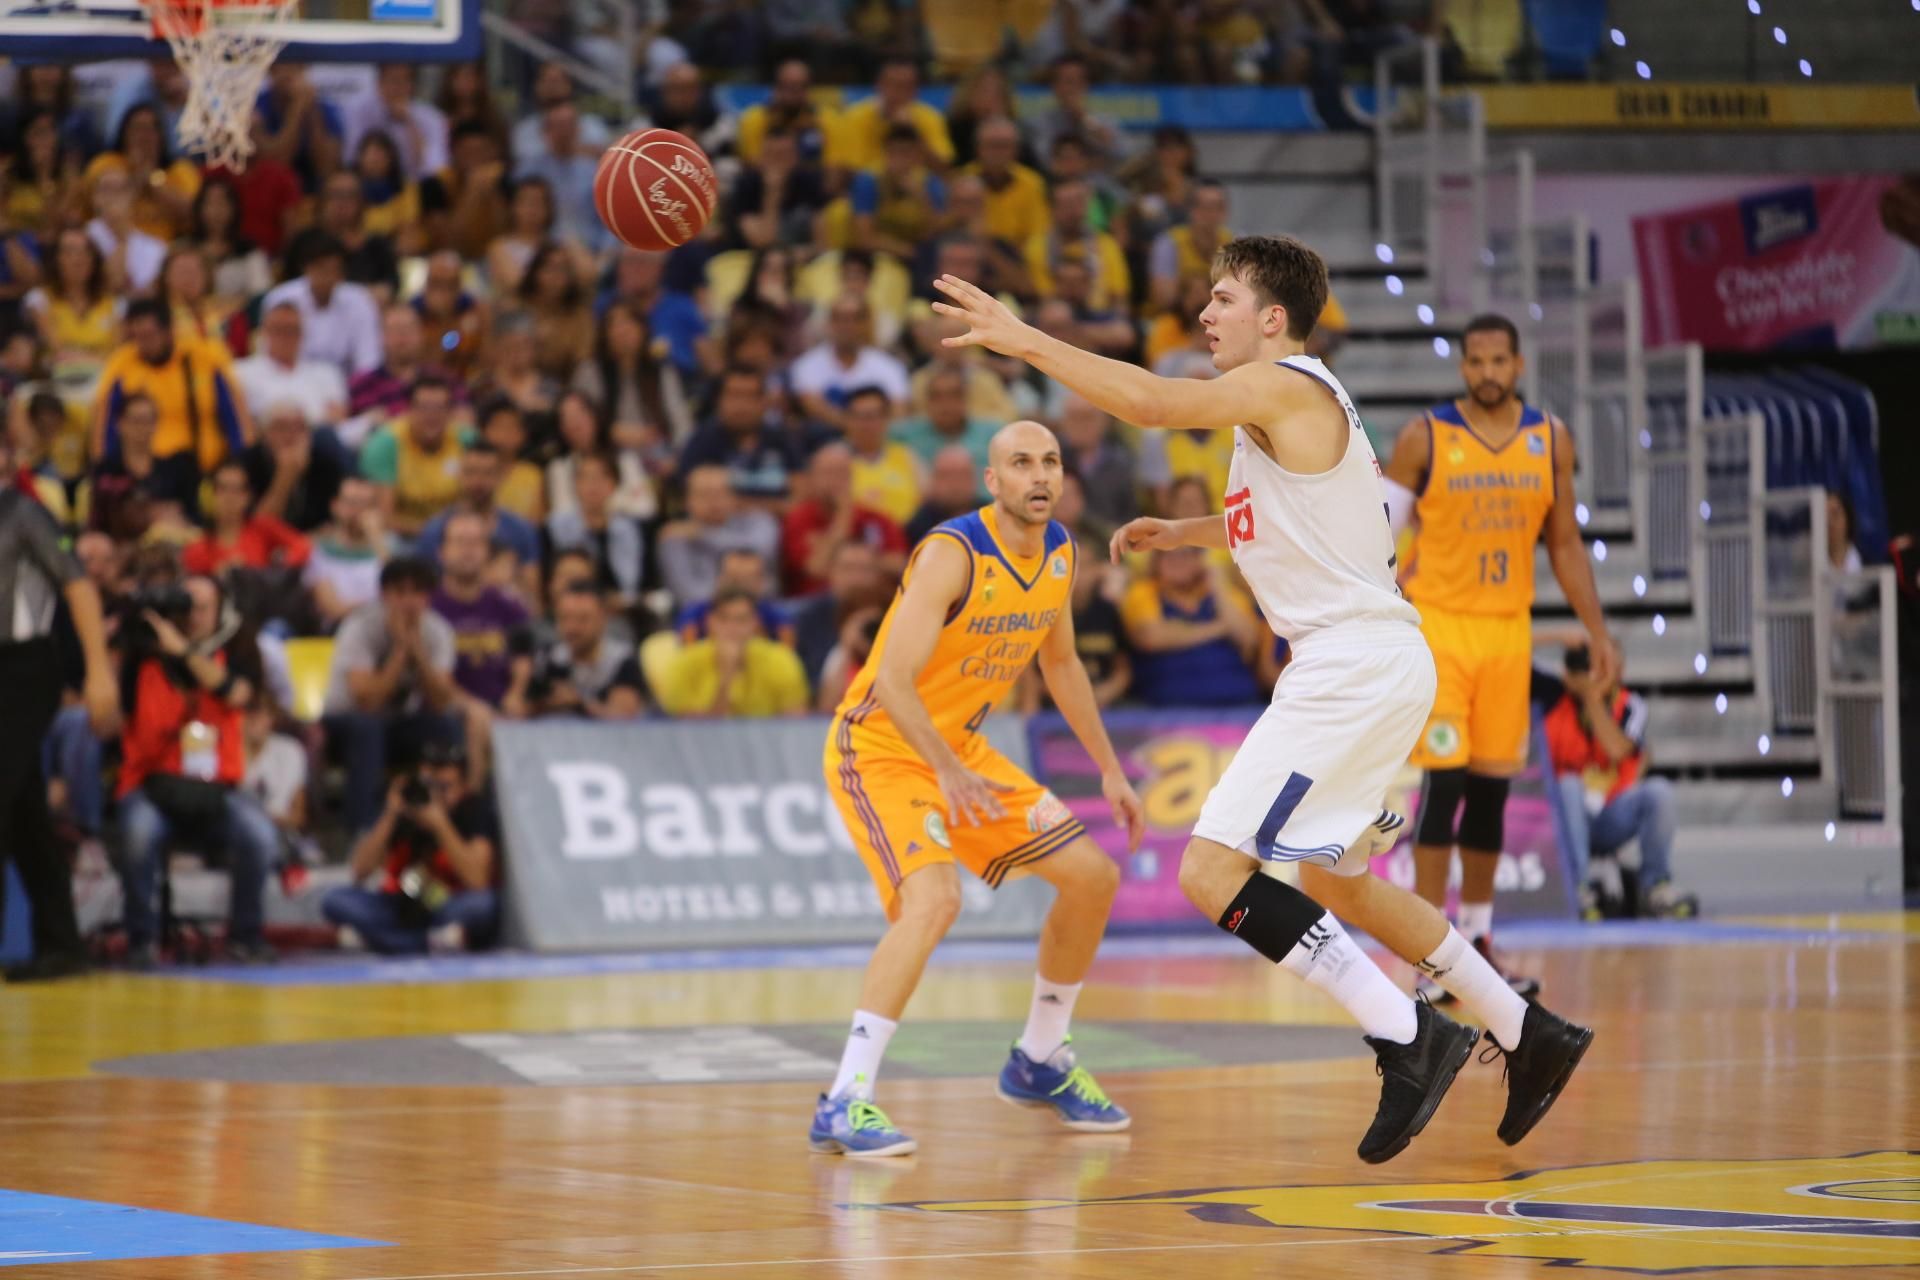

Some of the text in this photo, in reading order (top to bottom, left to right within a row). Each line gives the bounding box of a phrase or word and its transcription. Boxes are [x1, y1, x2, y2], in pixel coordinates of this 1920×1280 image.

[1447, 473, 1542, 494] HERBALIFE
[1478, 549, 1509, 585] 13
[964, 701, 992, 737] 4
[547, 761, 855, 860] Barc
[601, 884, 763, 922] HOTELS
[771, 885, 803, 918] &
